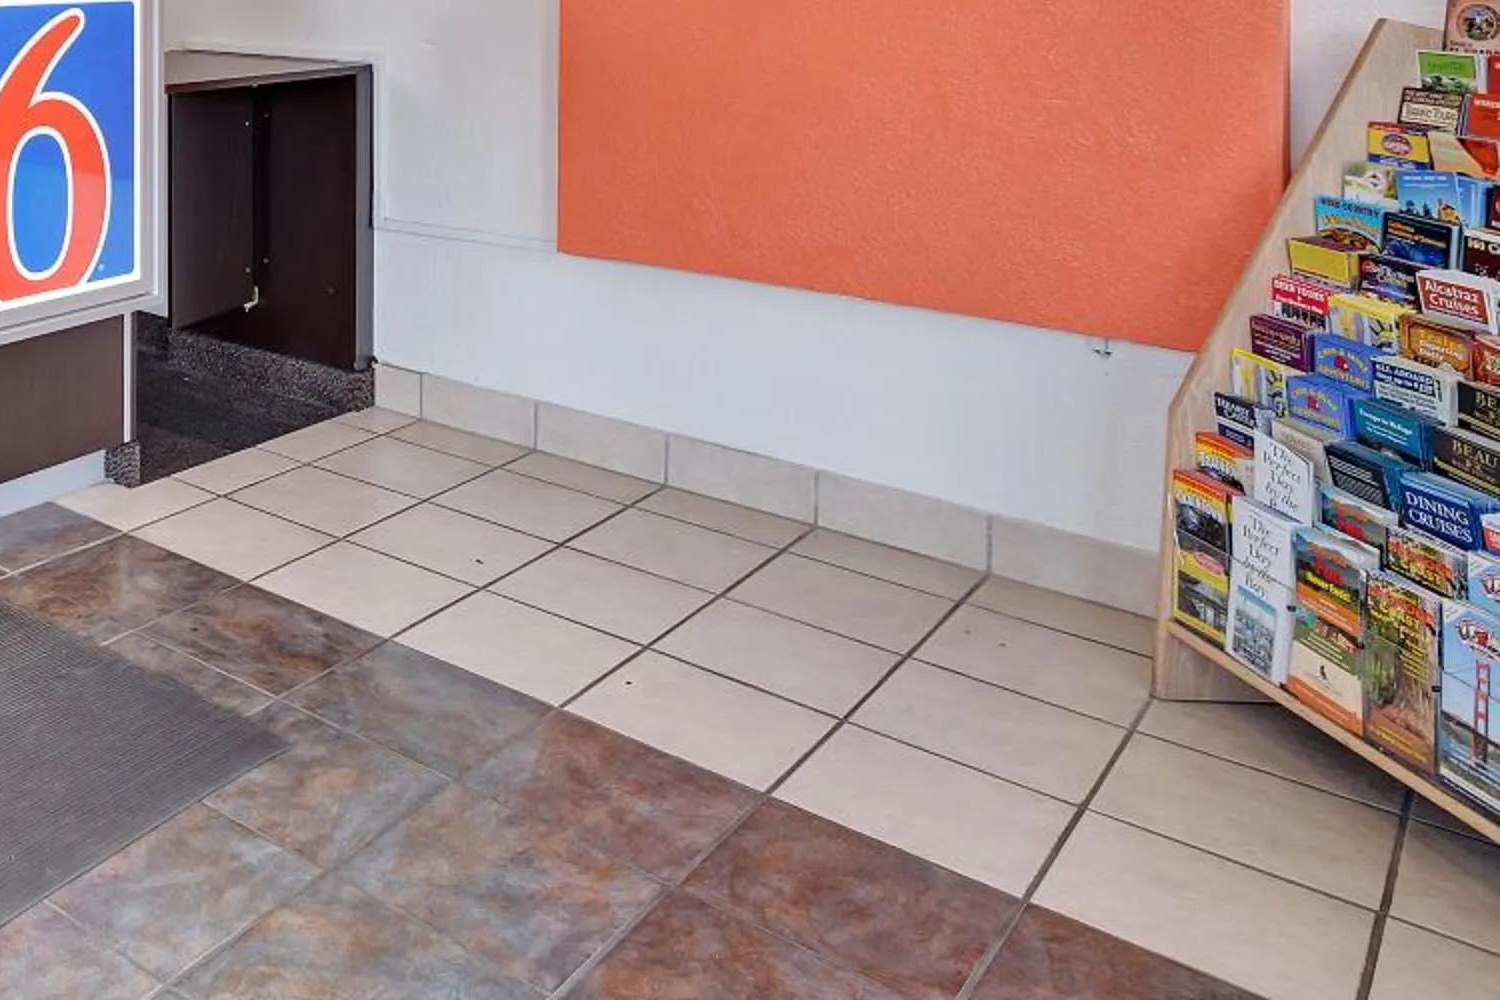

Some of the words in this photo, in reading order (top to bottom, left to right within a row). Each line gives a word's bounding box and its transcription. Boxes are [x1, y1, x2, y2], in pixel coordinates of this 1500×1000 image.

[1425, 279, 1479, 302] Alcatraz
[1428, 293, 1480, 316] Cruises
[1405, 491, 1469, 526] DINING
[1408, 508, 1474, 543] CRUISES
